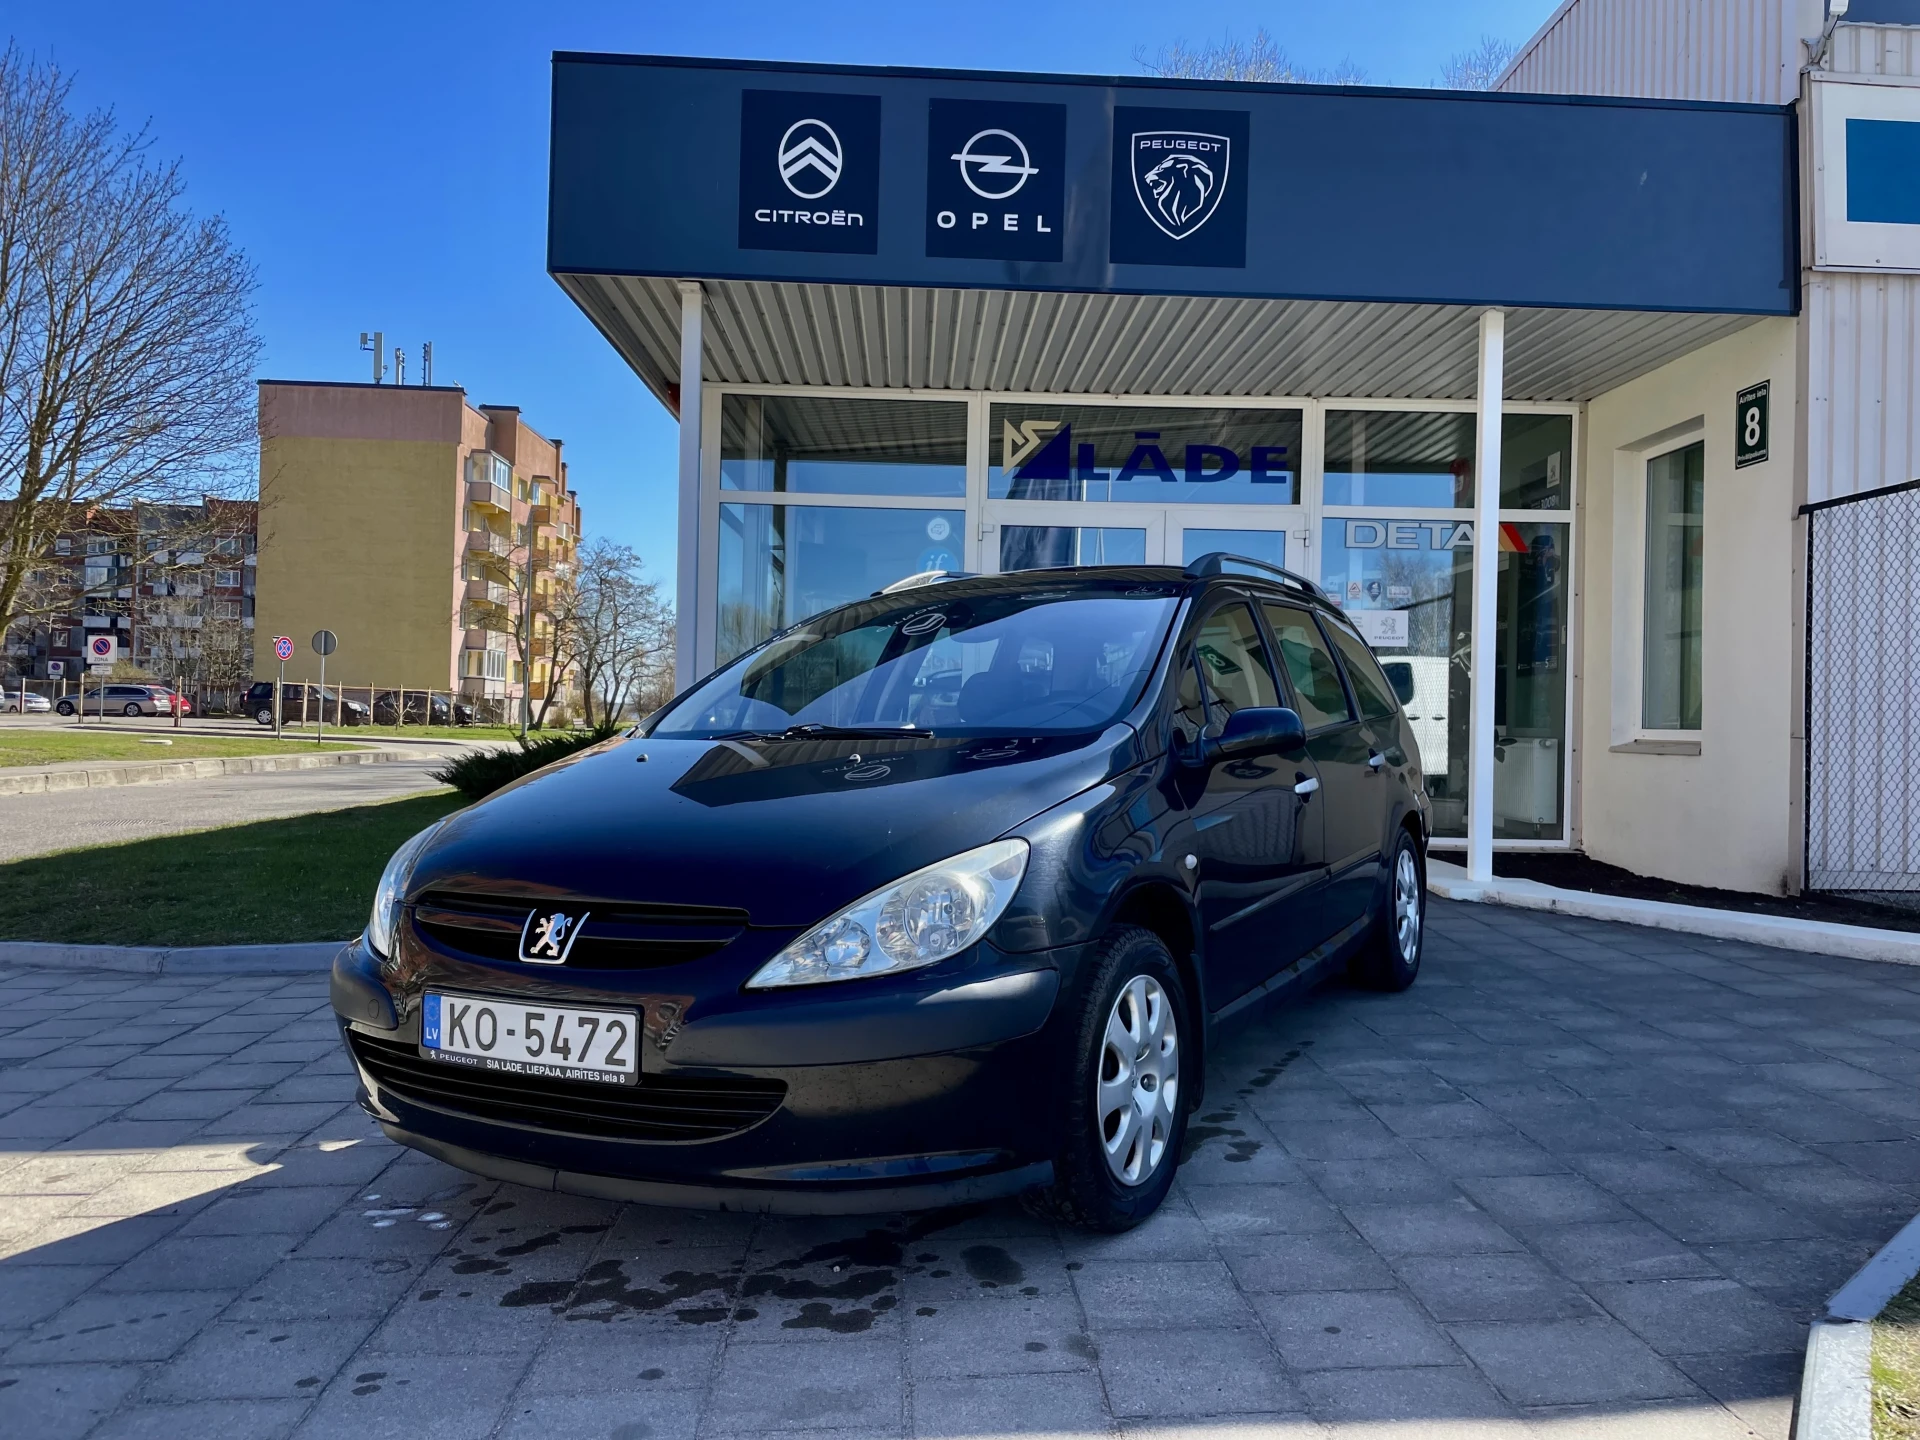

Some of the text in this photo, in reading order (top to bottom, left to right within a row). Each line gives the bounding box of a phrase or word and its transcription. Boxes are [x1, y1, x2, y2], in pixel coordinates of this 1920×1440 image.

[1139, 139, 1222, 153] PEUGEOT
[754, 209, 864, 227] CITROËN
[936, 210, 1052, 233] OPEL
[1745, 407, 1760, 446] 8
[1077, 431, 1288, 484] LĀDE
[426, 1027, 439, 1040] LV
[448, 1003, 627, 1067] KO-5472
[440, 1053, 478, 1065] PEUGEOT
[486, 1059, 500, 1069] SIA
[526, 1064, 564, 1078] LIEPĀJA,
[565, 1068, 600, 1081] AIRĪTES
[602, 1073, 618, 1083] iela
[619, 1074, 625, 1083] 8
